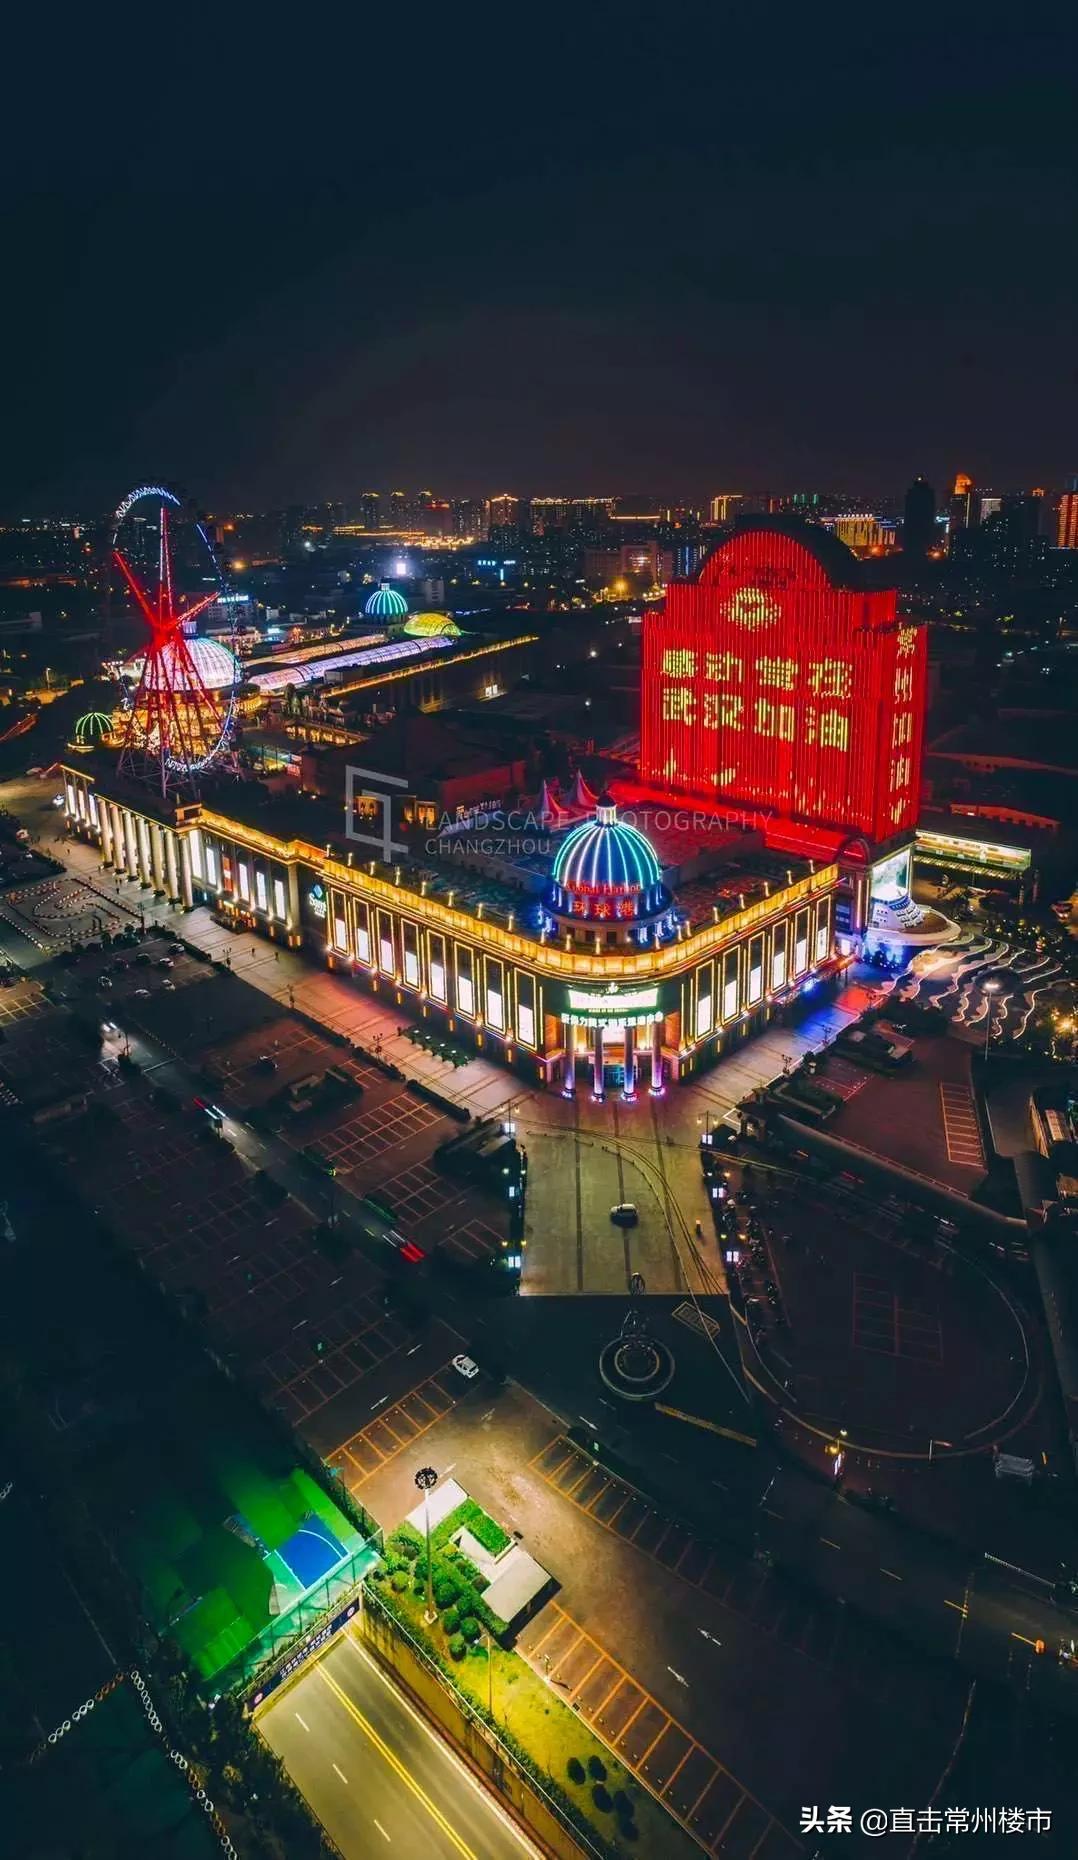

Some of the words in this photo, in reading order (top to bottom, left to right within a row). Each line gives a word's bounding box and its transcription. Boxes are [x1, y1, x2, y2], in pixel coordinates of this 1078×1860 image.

[662, 687, 850, 752] 武汉加油
[572, 899, 635, 917] 环球港
